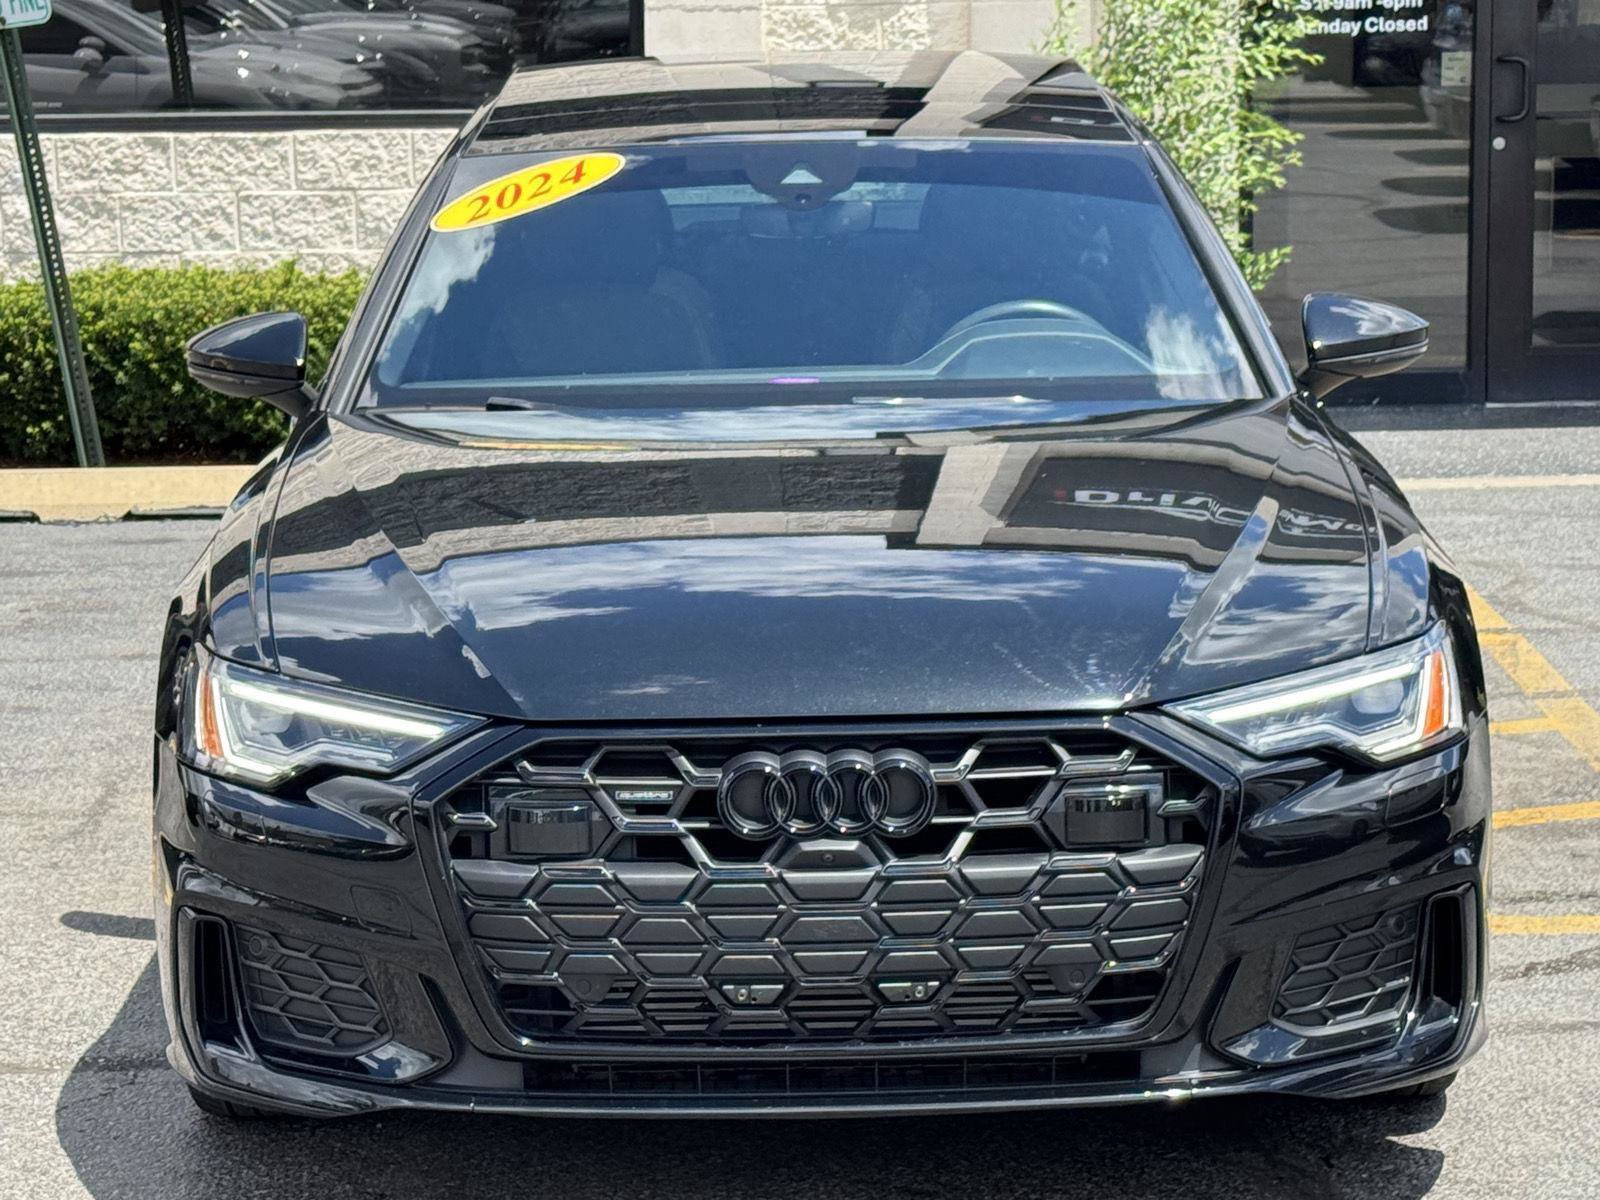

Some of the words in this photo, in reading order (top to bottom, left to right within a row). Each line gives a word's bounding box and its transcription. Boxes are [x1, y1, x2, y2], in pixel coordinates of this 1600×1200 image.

[1297, 17, 1361, 37] nday
[1364, 15, 1429, 33] Closed
[466, 159, 587, 225] 2024
